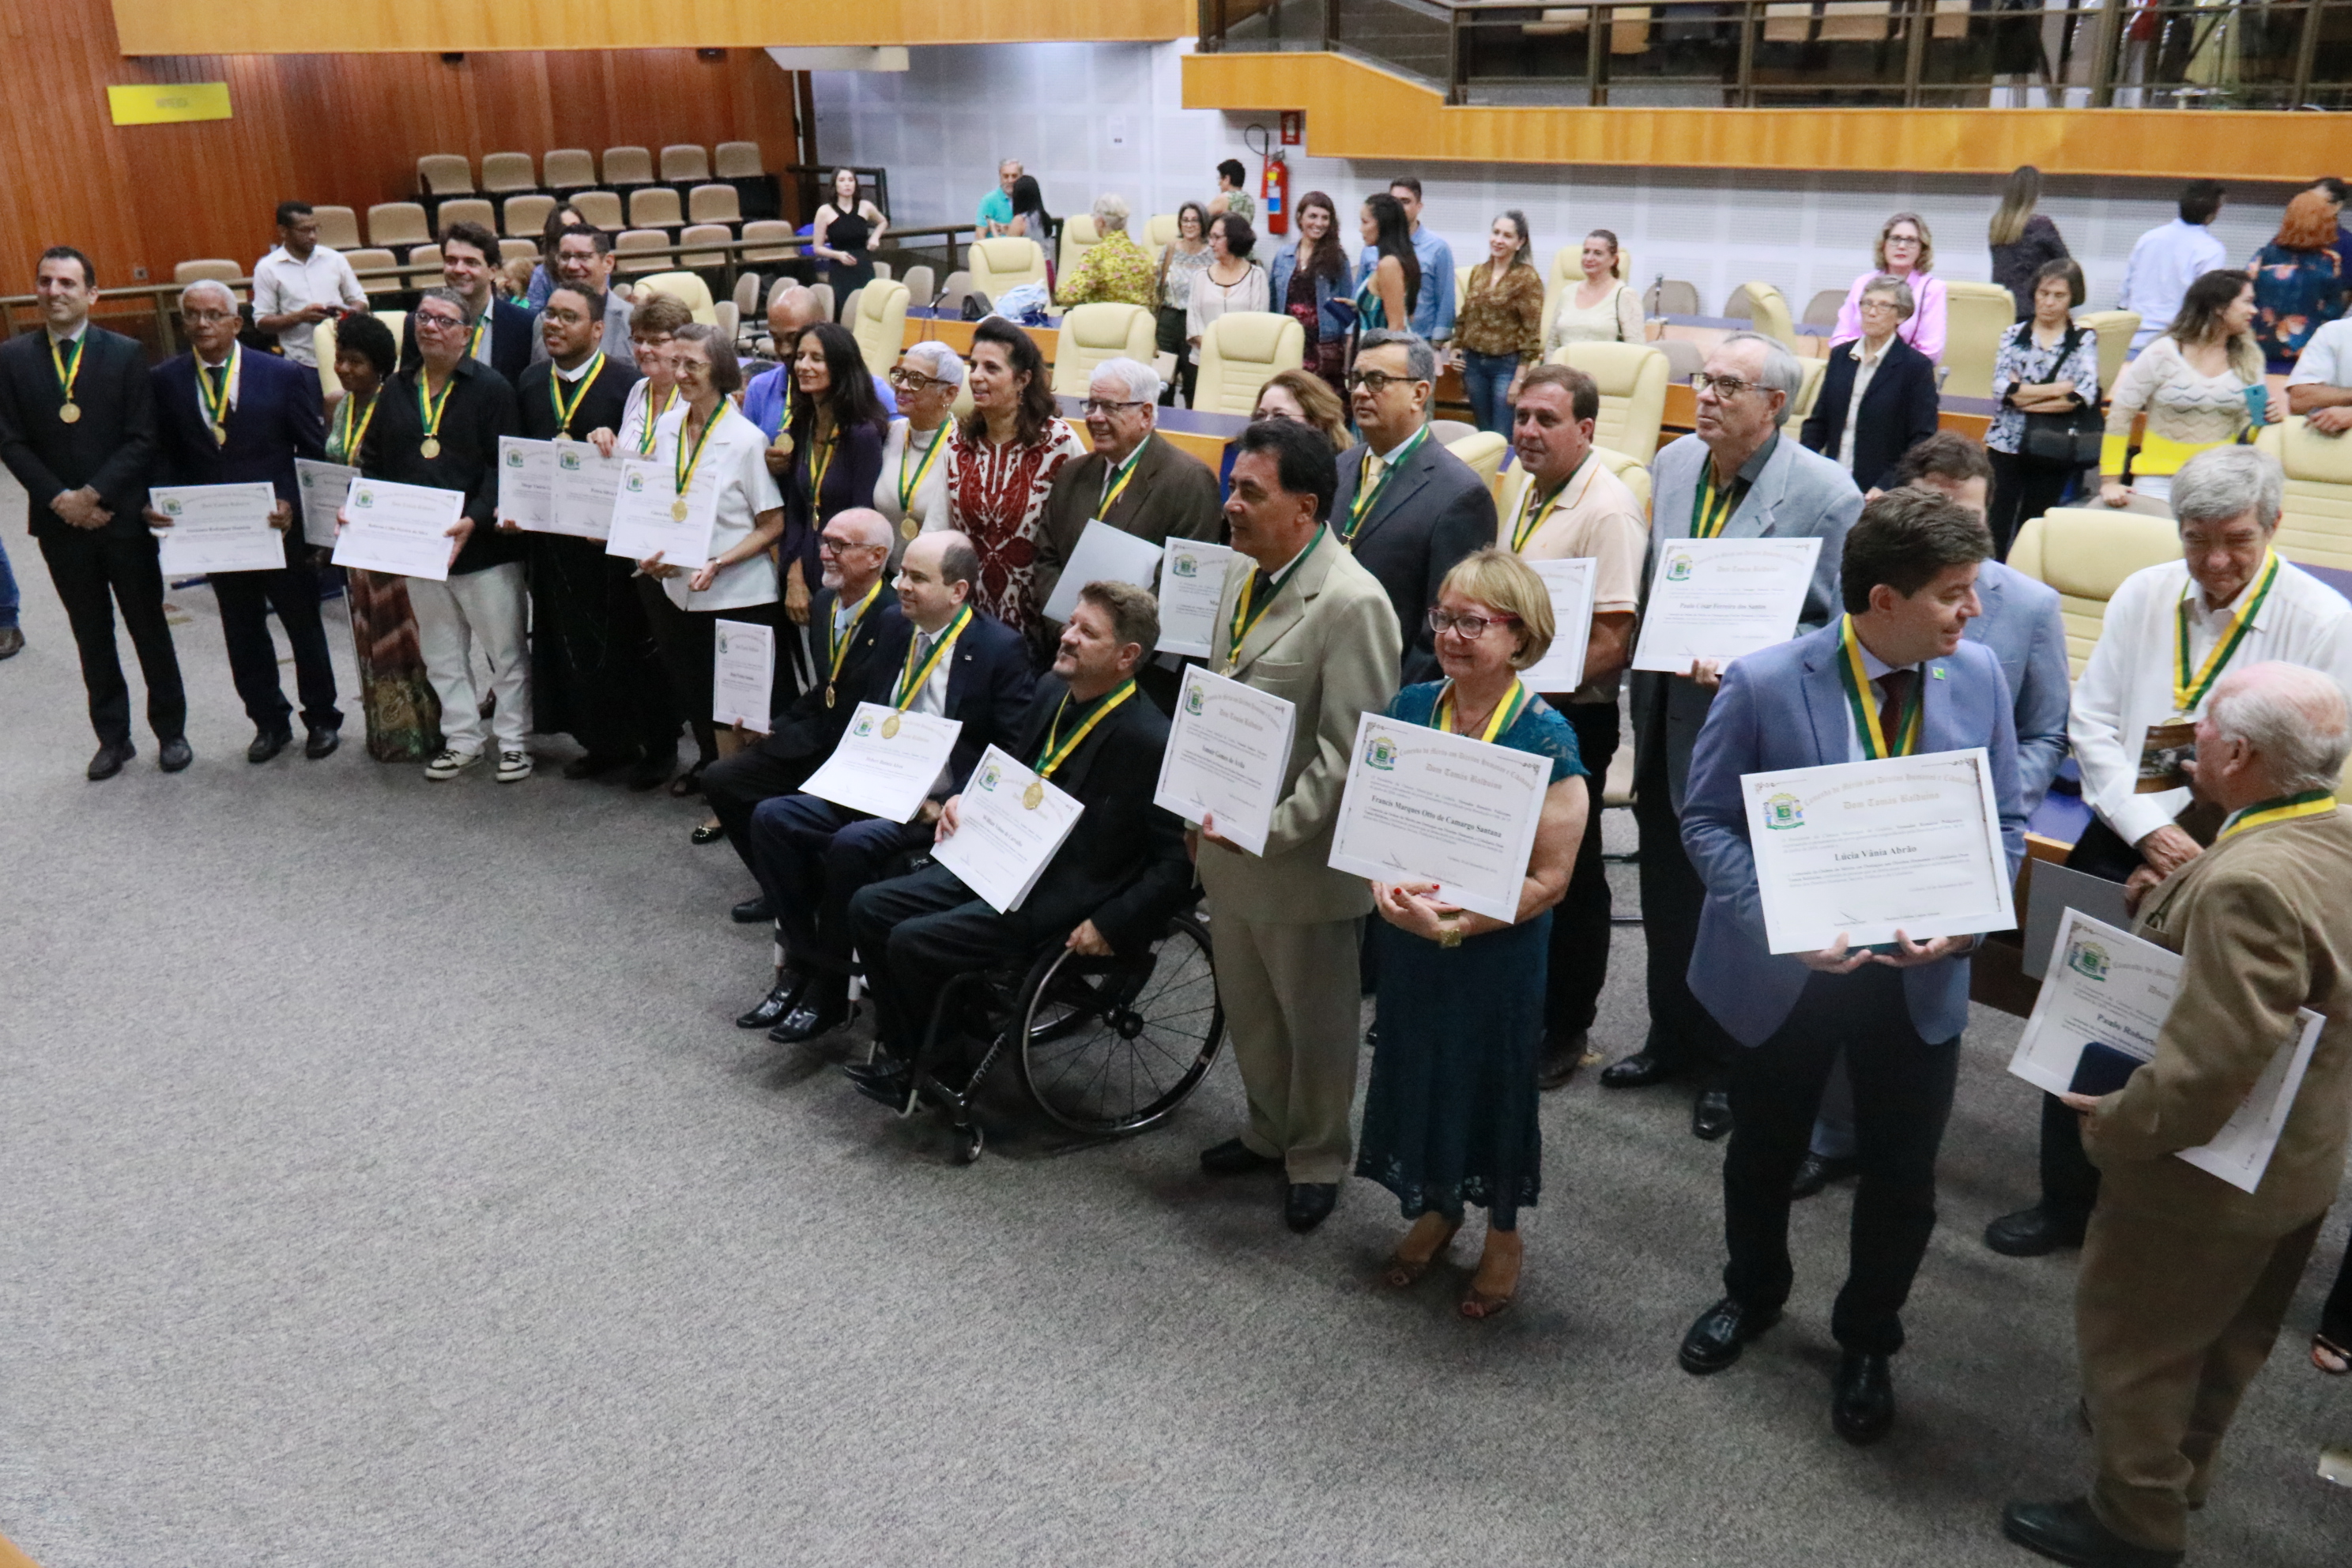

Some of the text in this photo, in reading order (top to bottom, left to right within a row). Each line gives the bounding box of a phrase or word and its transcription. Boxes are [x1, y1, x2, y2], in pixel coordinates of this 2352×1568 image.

[1425, 763, 1442, 774] Dom
[1843, 801, 1864, 810] Dom
[1371, 794, 1393, 808] Francis
[1396, 801, 1420, 816] Marques
[1422, 808, 1436, 820] Otto
[1438, 812, 1445, 822] de
[1446, 816, 1476, 831] Camargo
[1476, 824, 1502, 839] Santana
[1835, 844, 1917, 861] Lúcia Vânia Abrão
